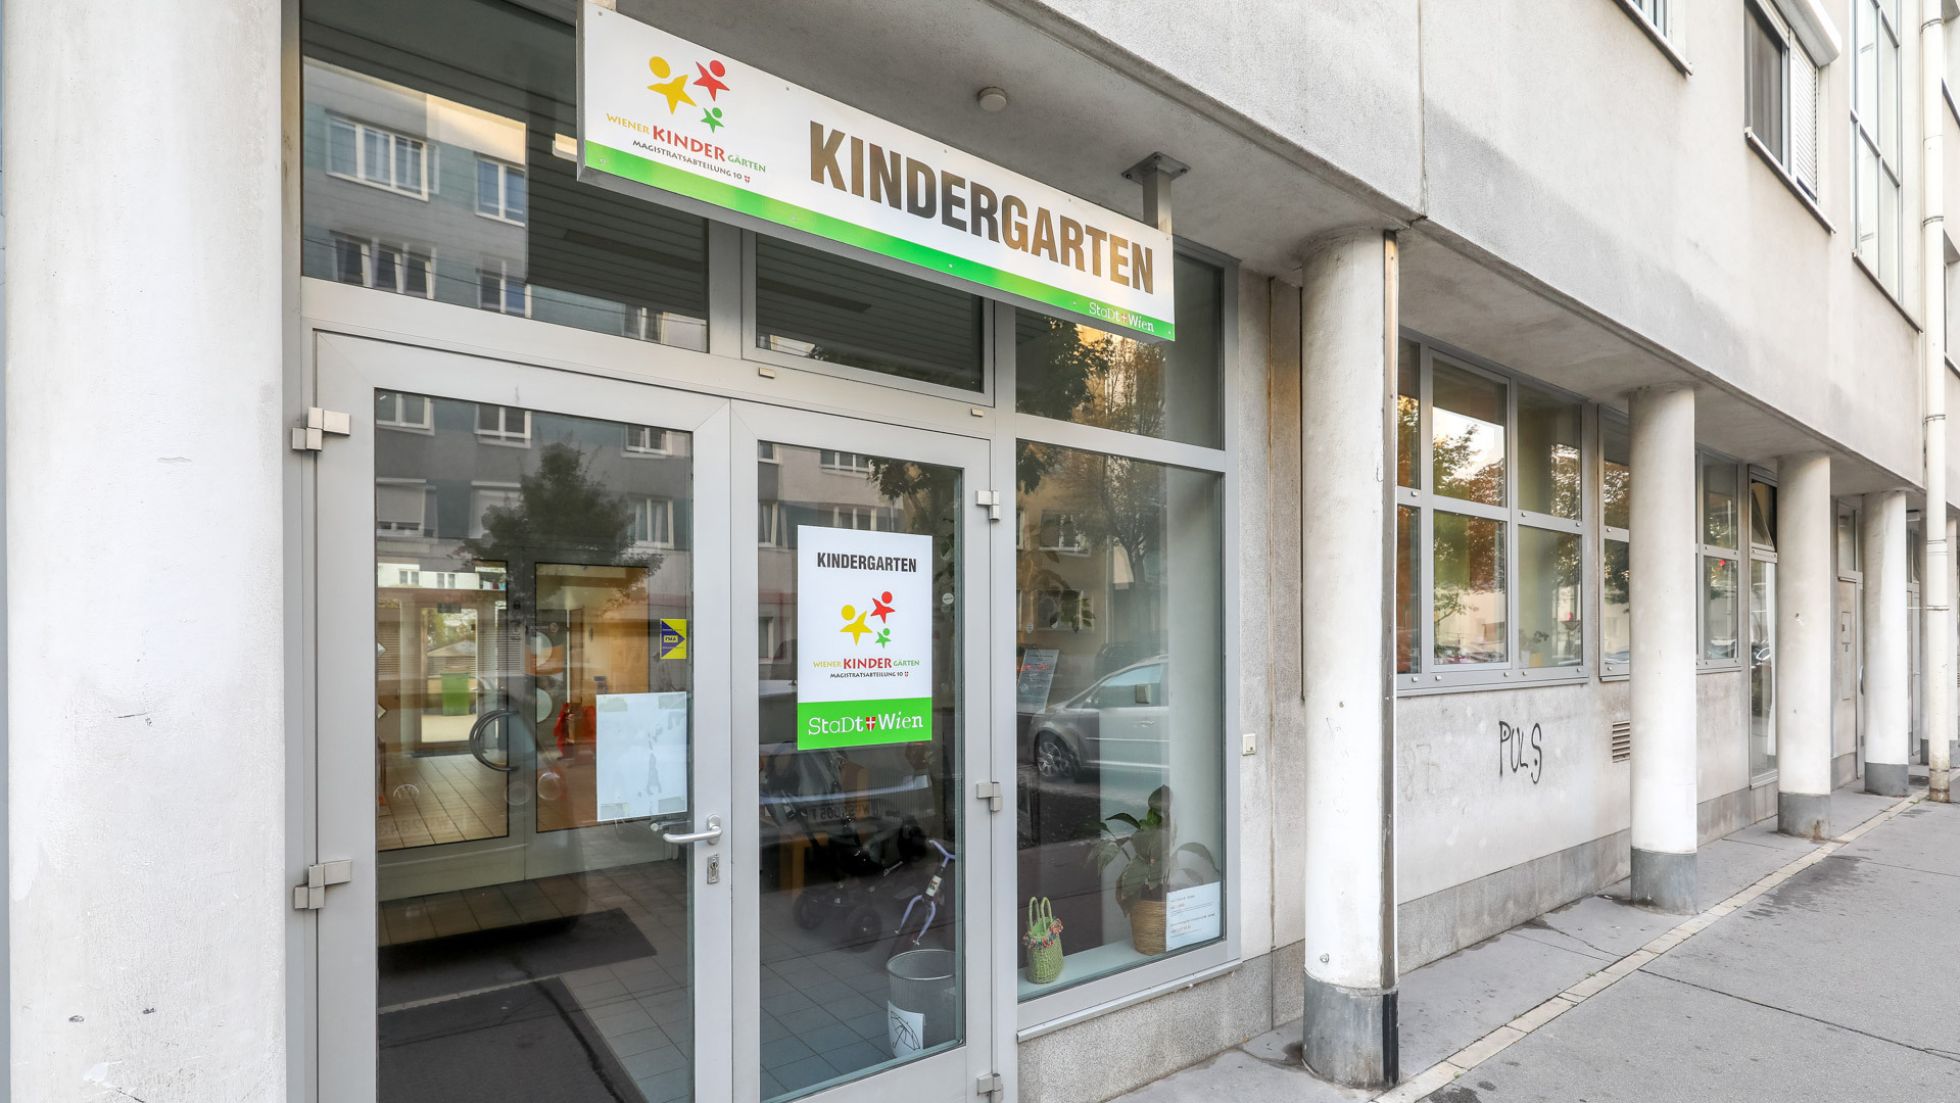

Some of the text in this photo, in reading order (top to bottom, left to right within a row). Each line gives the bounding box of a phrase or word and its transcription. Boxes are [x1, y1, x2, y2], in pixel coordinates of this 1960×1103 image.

[606, 112, 650, 134] WIENER
[652, 124, 726, 163] KINDER
[632, 140, 744, 181] MAGISTRATSABTEILUNG 10
[810, 120, 1154, 295] KINDERGARTEN
[1127, 313, 1155, 332] Wien
[817, 551, 917, 573] KINDERGARTEN
[813, 660, 842, 668] WIENER
[843, 657, 892, 669] KINDER
[829, 671, 896, 679] MAGISTRATSABTEILUNG
[877, 711, 924, 731] Wien
